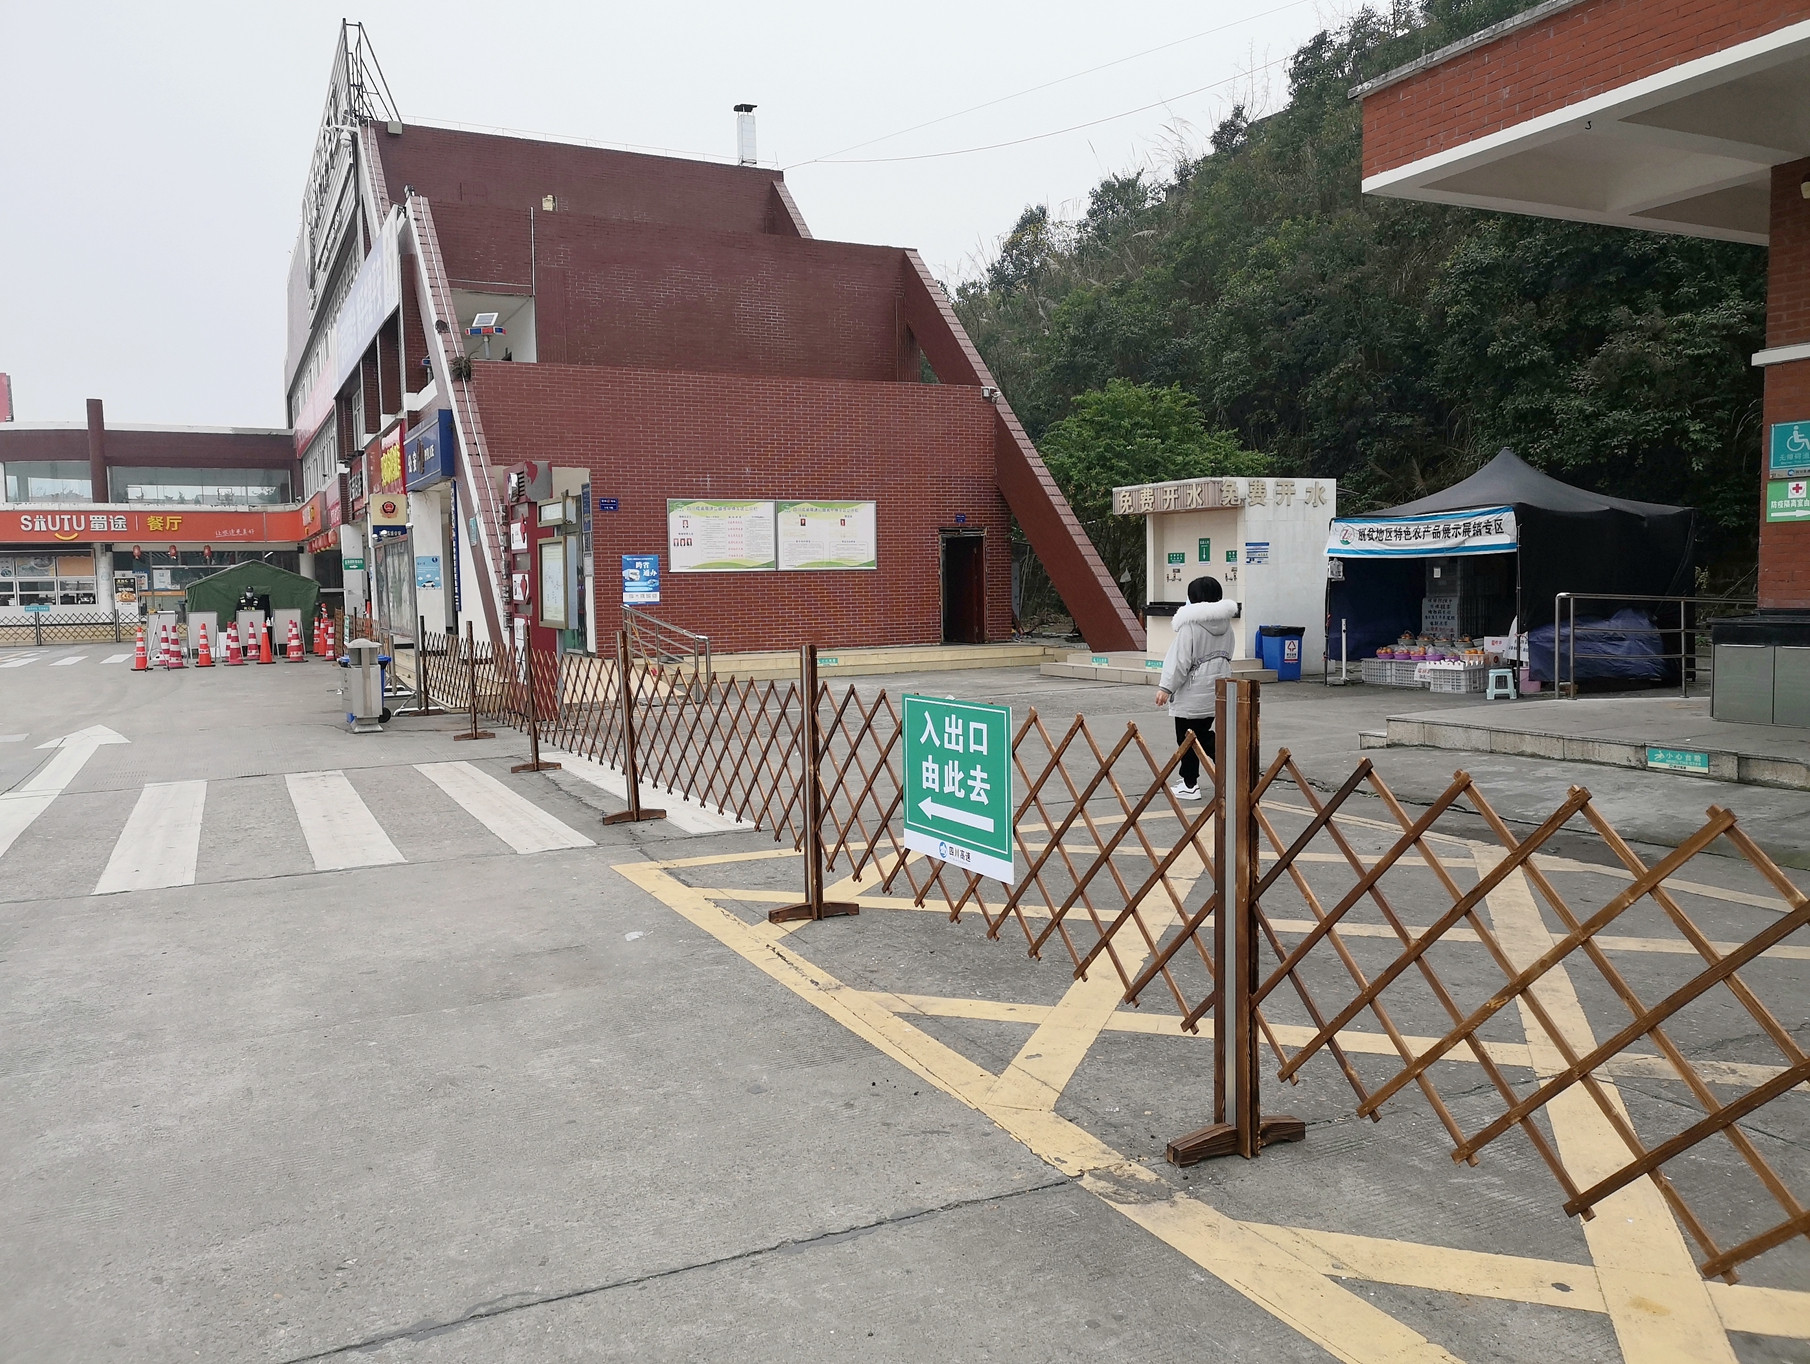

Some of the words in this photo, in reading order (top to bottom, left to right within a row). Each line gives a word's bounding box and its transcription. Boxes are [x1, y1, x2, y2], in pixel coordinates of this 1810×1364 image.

[1118, 483, 1204, 514] 免费开水
[1220, 479, 1328, 508] 免费开水
[89, 514, 128, 532] 蜀途
[146, 515, 183, 532] 餐厅
[919, 710, 988, 756] 入出口
[922, 754, 991, 806] 由此去
[948, 845, 972, 863] 四川高速
